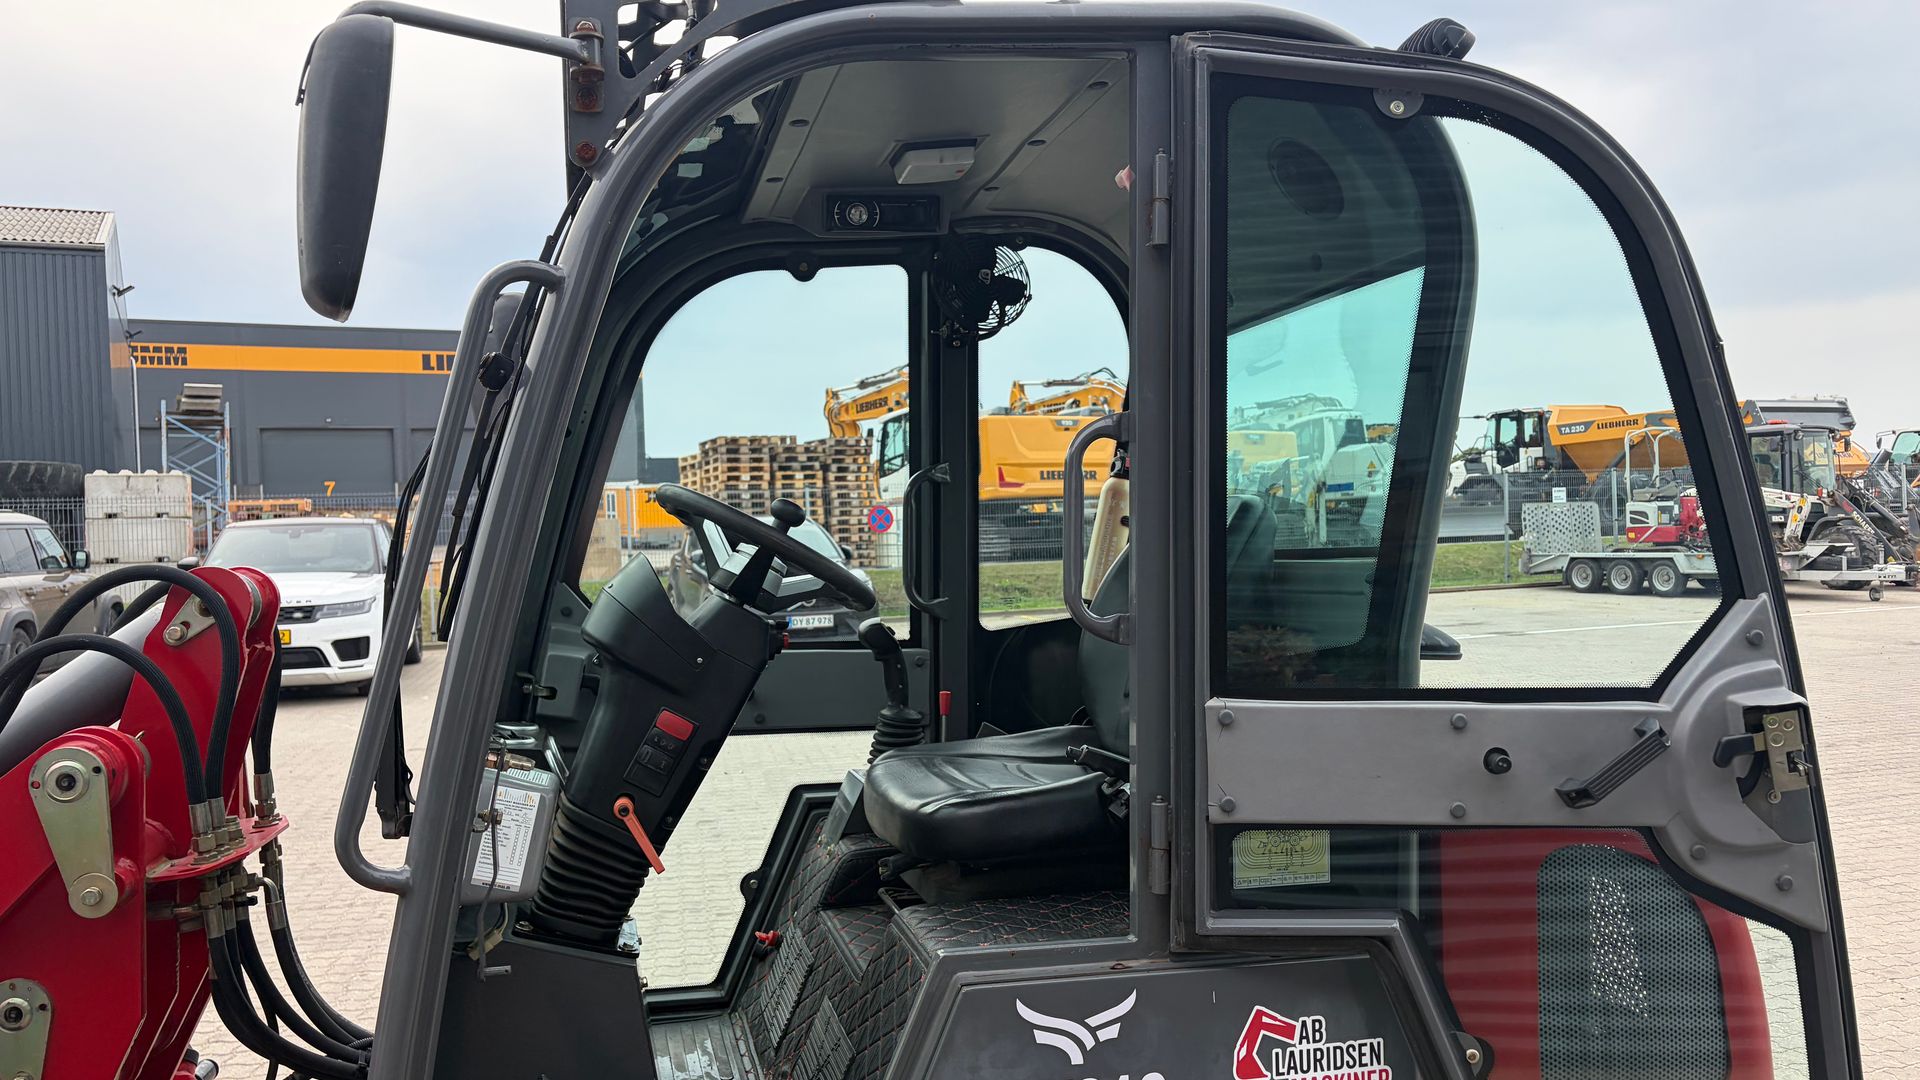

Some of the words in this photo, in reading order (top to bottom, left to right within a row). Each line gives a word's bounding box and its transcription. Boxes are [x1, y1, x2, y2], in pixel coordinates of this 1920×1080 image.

[856, 396, 888, 414] LIEBHERR
[1570, 425, 1585, 433] 230
[1597, 419, 1639, 430] LIEBHERR
[1040, 470, 1097, 480] LIEBRR
[324, 481, 336, 497] 7
[1298, 1018, 1324, 1045] AB
[1274, 1041, 1382, 1077] LAURIDSEN
